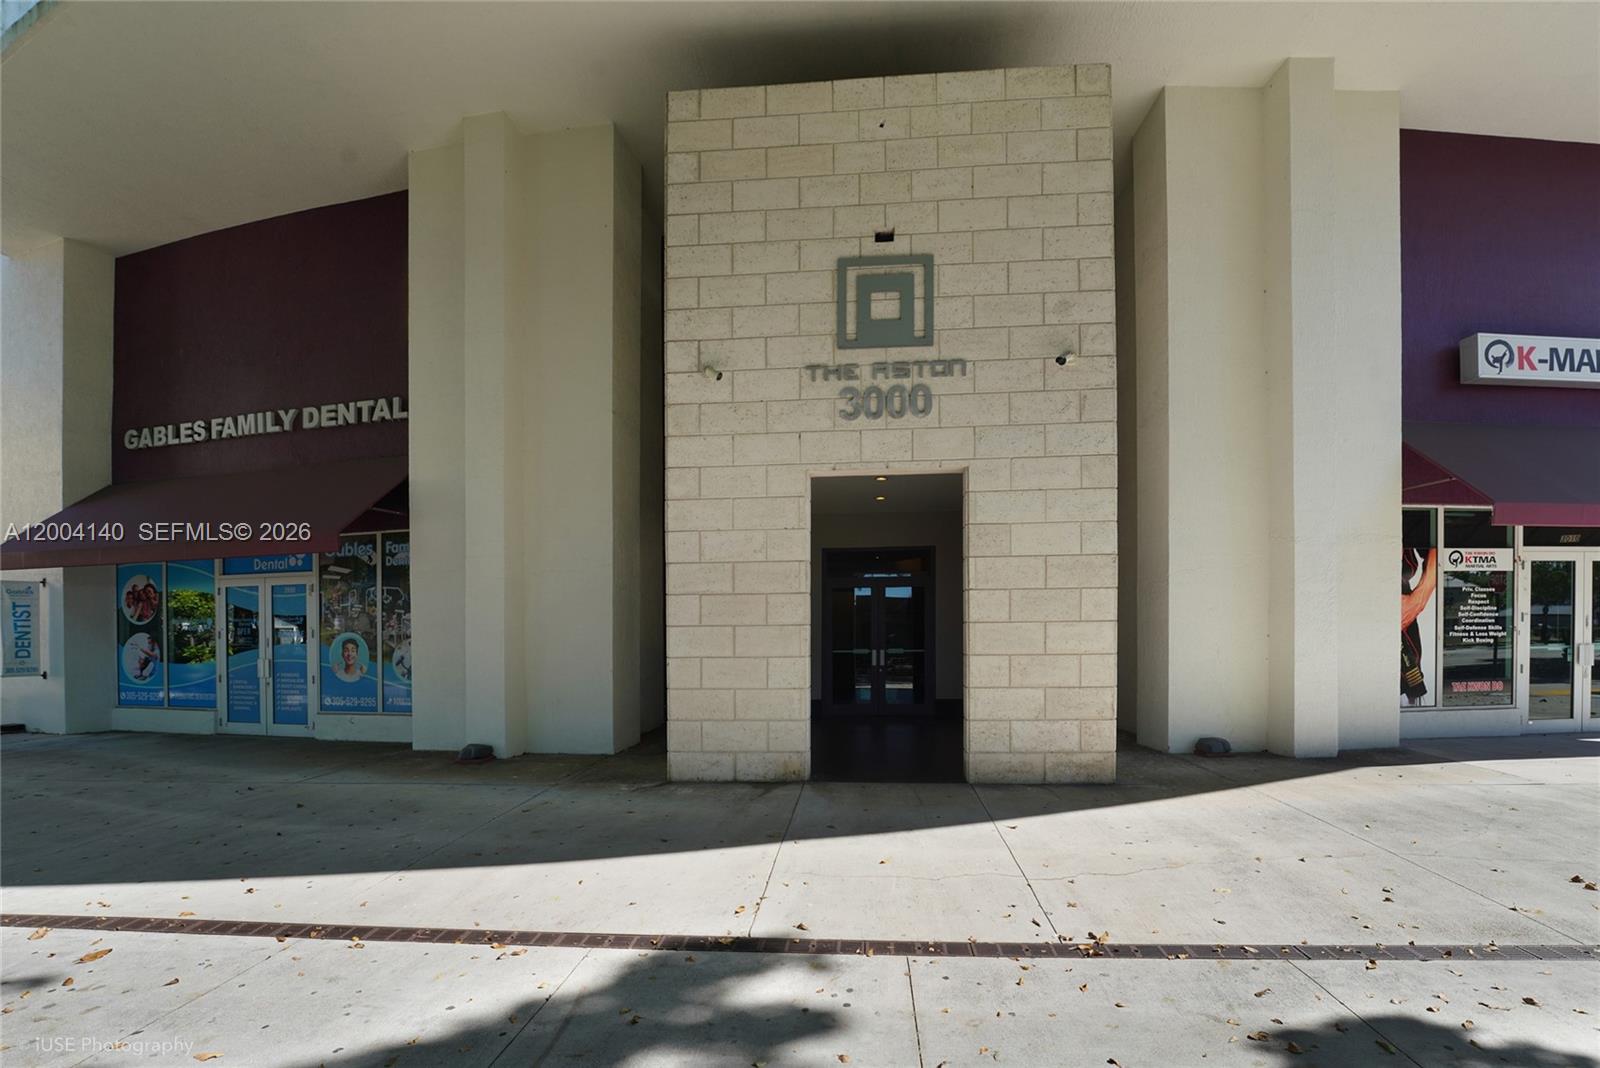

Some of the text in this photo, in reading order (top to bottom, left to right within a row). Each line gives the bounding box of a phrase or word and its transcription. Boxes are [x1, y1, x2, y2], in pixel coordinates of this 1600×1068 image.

[805, 358, 967, 382] THE ASTON
[839, 383, 933, 421] 3000
[124, 397, 408, 450] GABLES FAMILY DENTAL
[254, 557, 288, 571] Dental
[325, 541, 374, 557] ables
[12, 601, 31, 659] DENTIST
